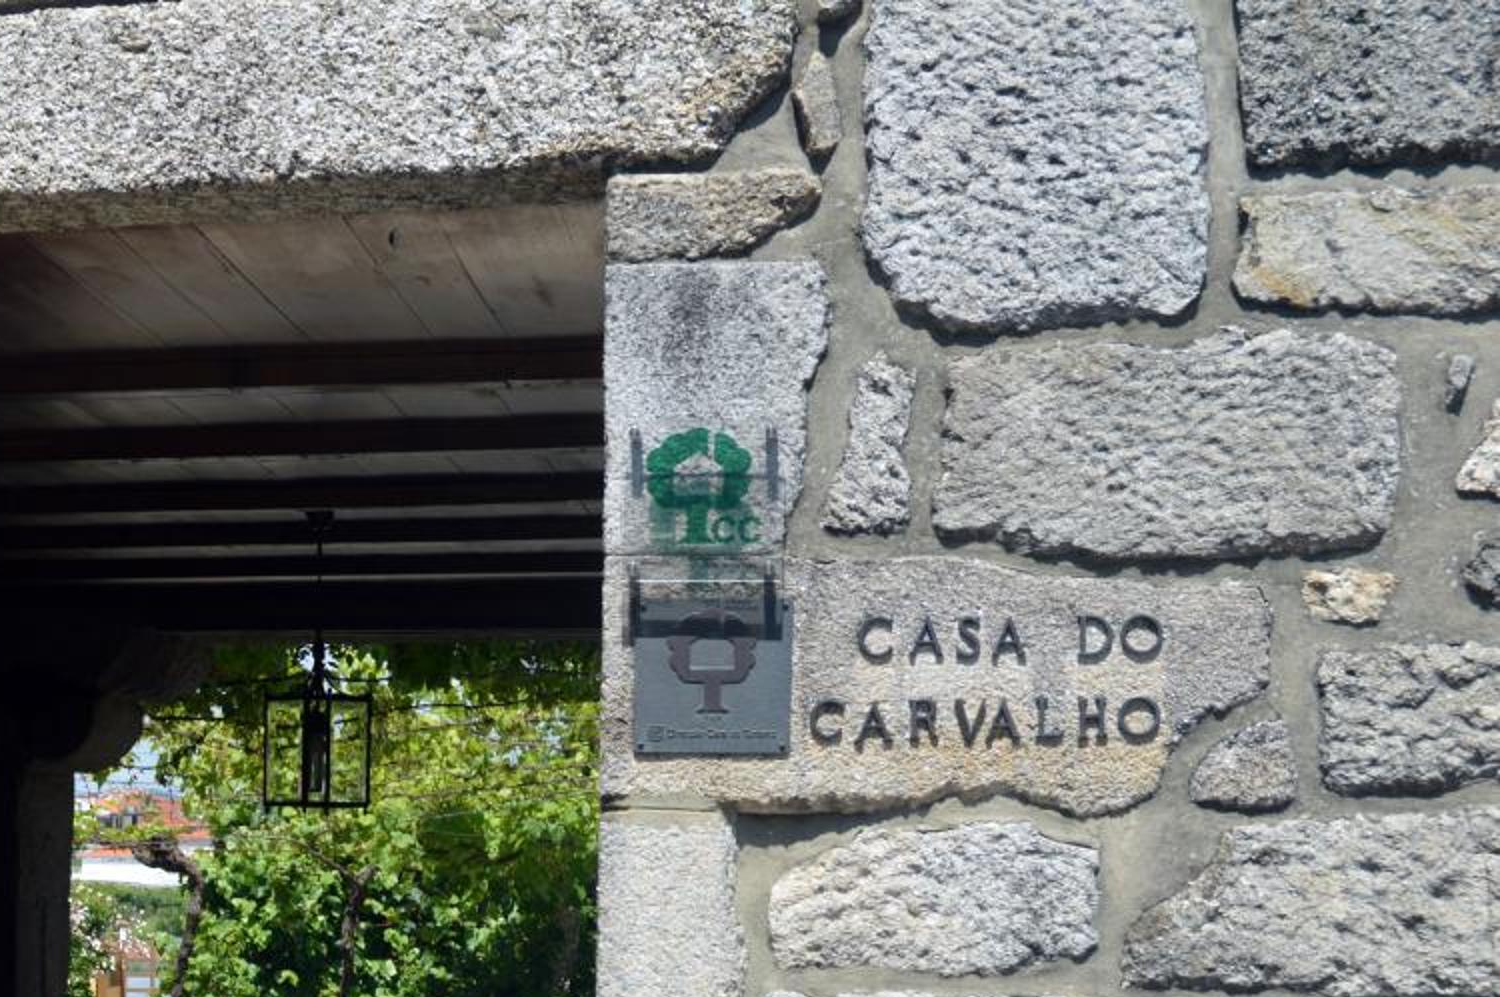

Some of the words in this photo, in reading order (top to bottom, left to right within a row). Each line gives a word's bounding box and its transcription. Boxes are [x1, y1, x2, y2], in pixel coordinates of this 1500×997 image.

[856, 615, 1027, 666] CASA
[1077, 614, 1165, 664] DO
[809, 697, 1161, 752] CARVALHO
